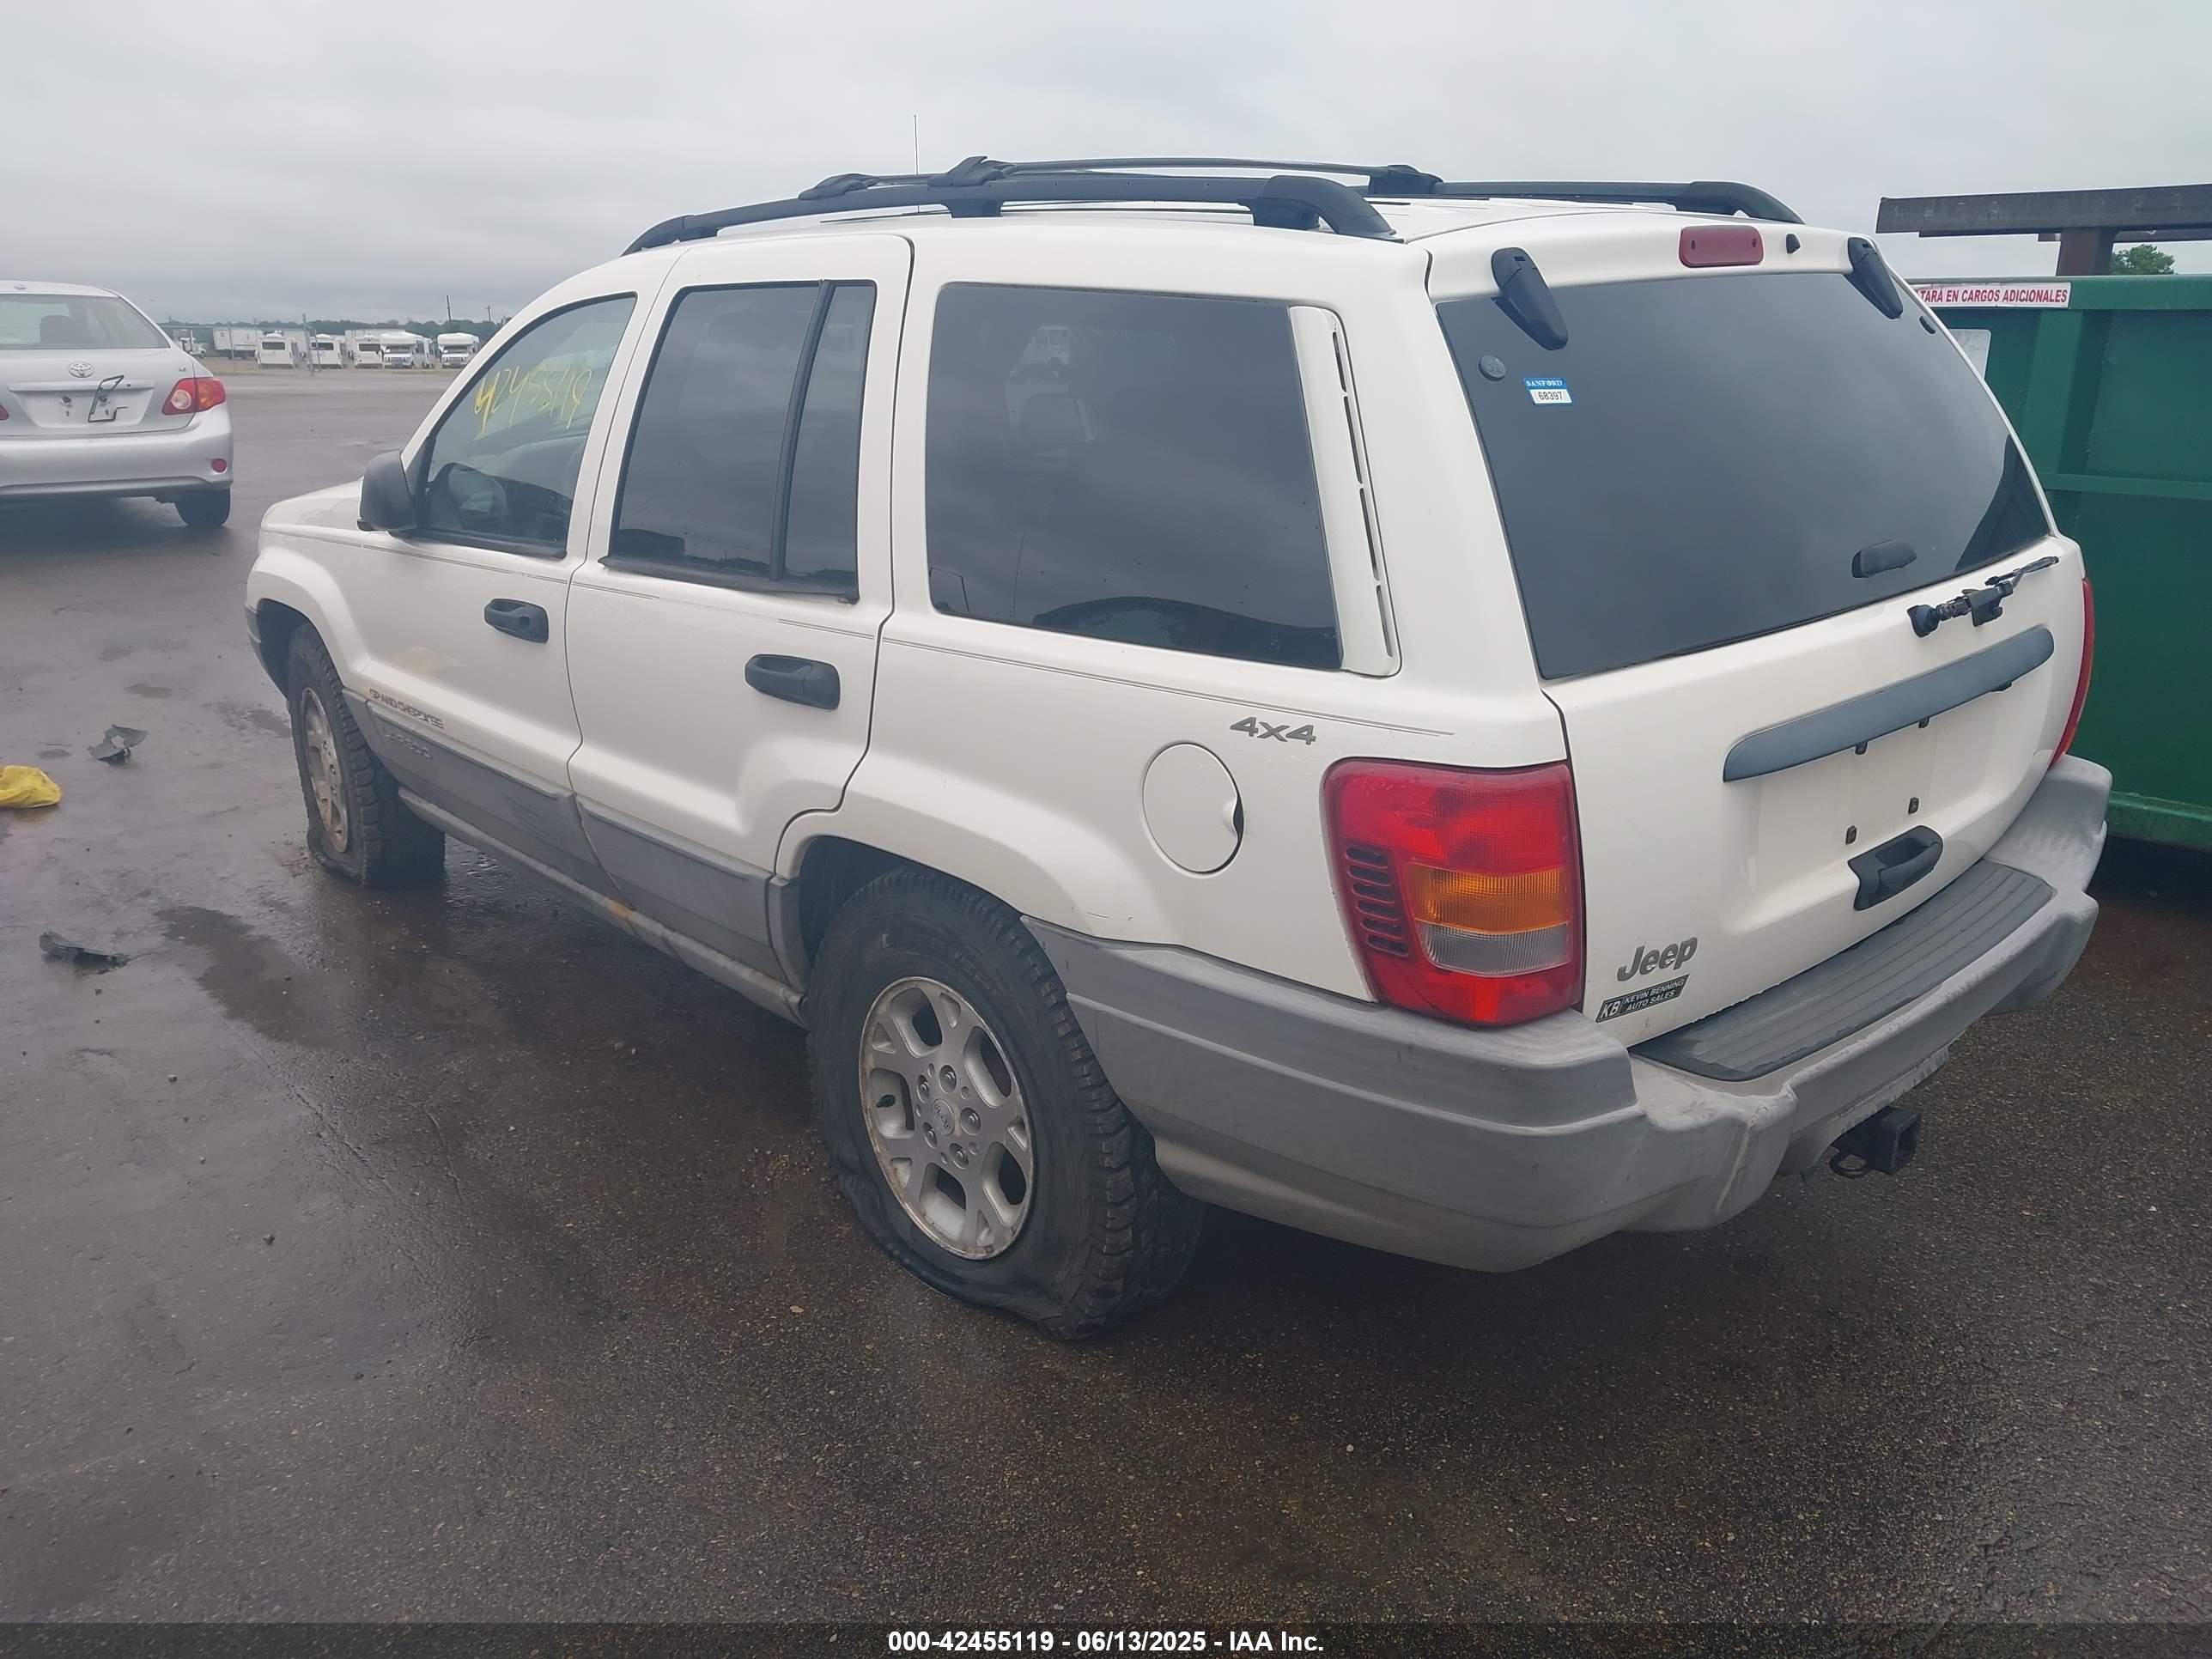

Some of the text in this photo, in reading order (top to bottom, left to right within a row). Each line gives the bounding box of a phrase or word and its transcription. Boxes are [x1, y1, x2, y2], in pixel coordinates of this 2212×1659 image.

[1946, 290, 1959, 302] EN
[1961, 289, 2000, 302] CARGOS
[2002, 289, 2067, 302] ADICIONALES
[1538, 392, 1563, 400] 68397
[1617, 937, 1698, 981] Jeep
[1624, 991, 1650, 1004] KEVIN
[1626, 989, 1676, 1012] AUTO SALES
[1601, 1000, 1621, 1019] KB
